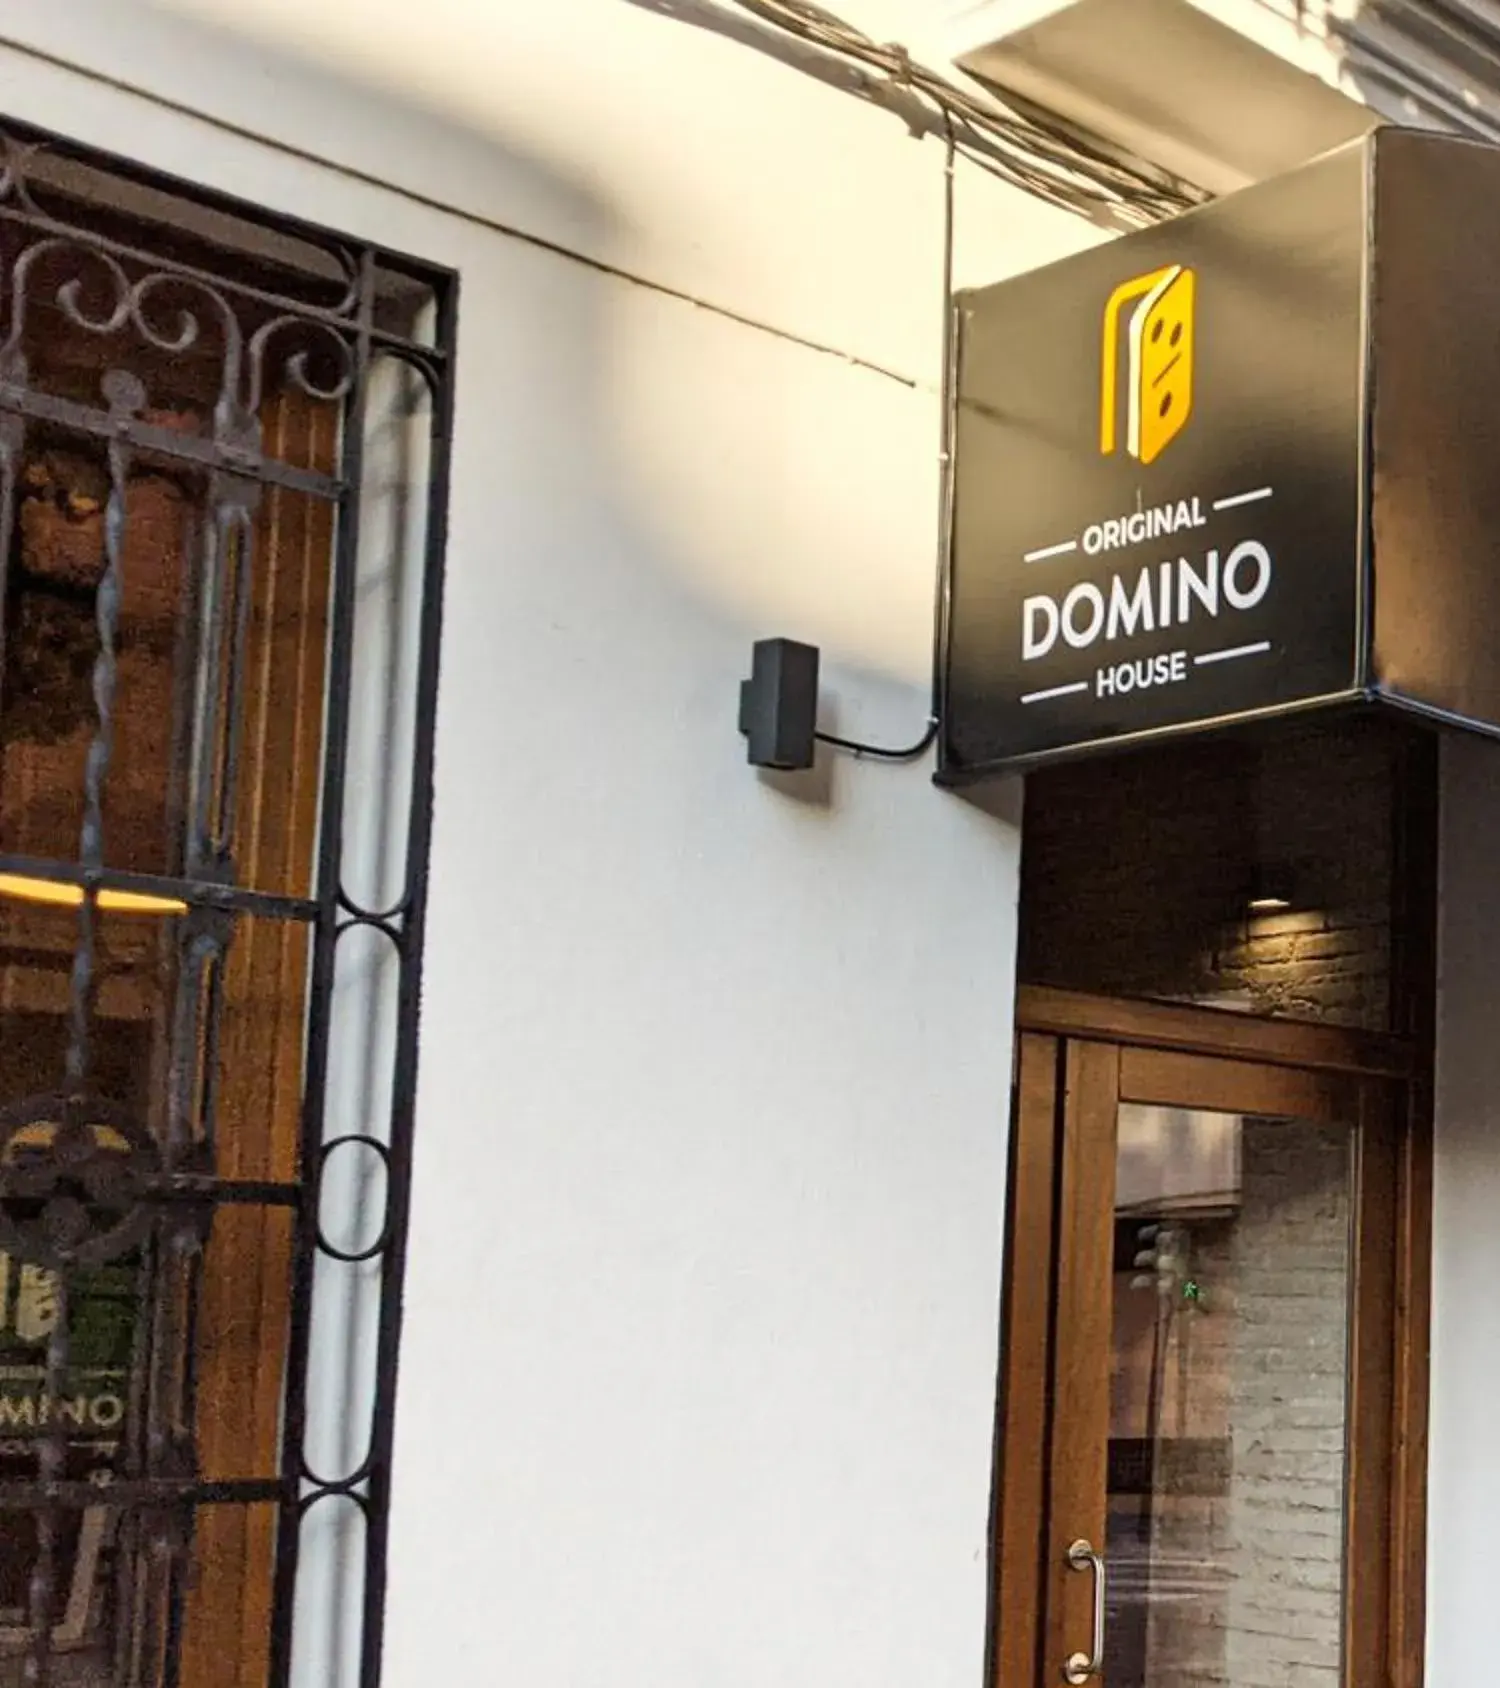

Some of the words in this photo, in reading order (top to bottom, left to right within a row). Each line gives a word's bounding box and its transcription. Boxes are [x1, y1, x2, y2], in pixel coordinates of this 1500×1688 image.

[1083, 497, 1207, 555] ORIGINAL
[1022, 540, 1271, 661] DOMINO
[1096, 651, 1188, 698] HOUSE
